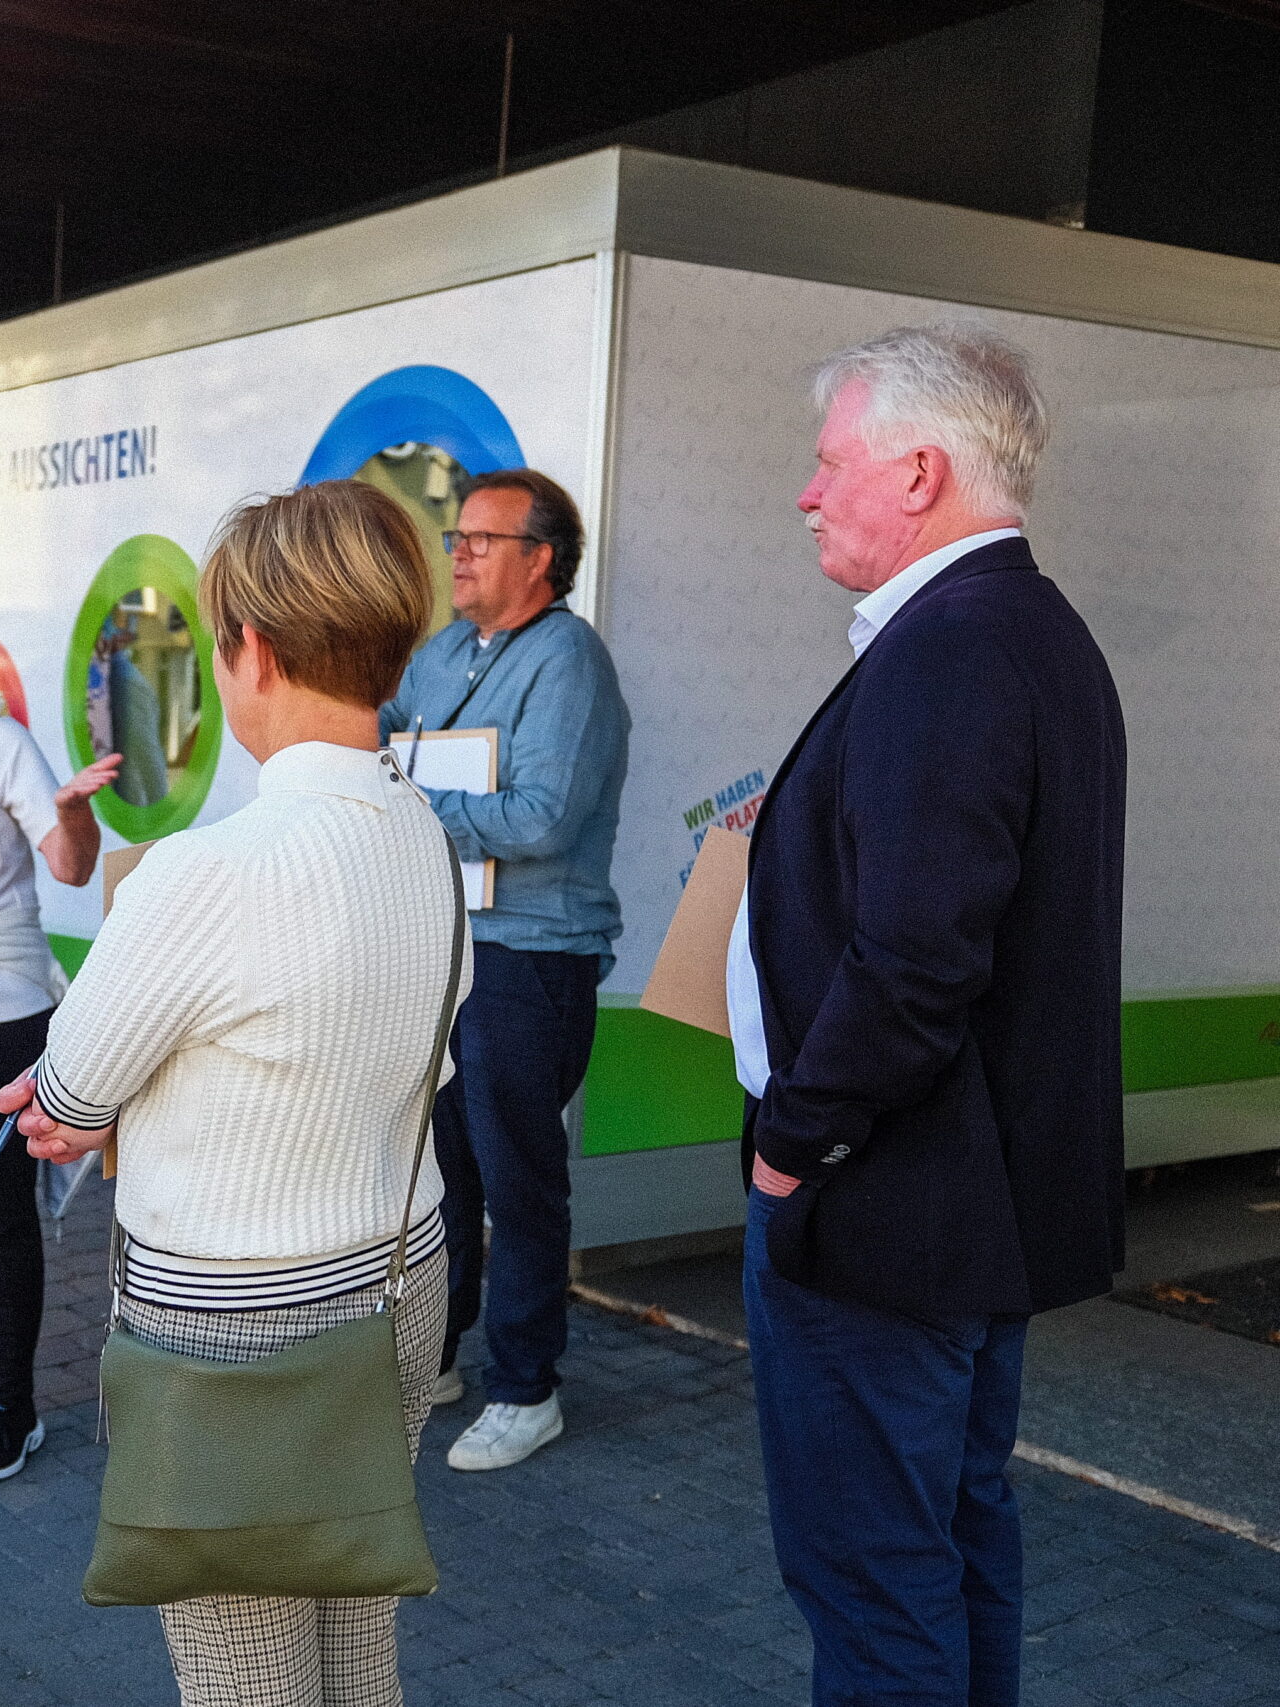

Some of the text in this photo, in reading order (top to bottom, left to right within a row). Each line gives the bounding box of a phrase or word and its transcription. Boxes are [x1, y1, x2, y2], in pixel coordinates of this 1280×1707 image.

[6, 424, 158, 493] AUSSICHTEN!
[682, 768, 766, 831] WIR HABEN
